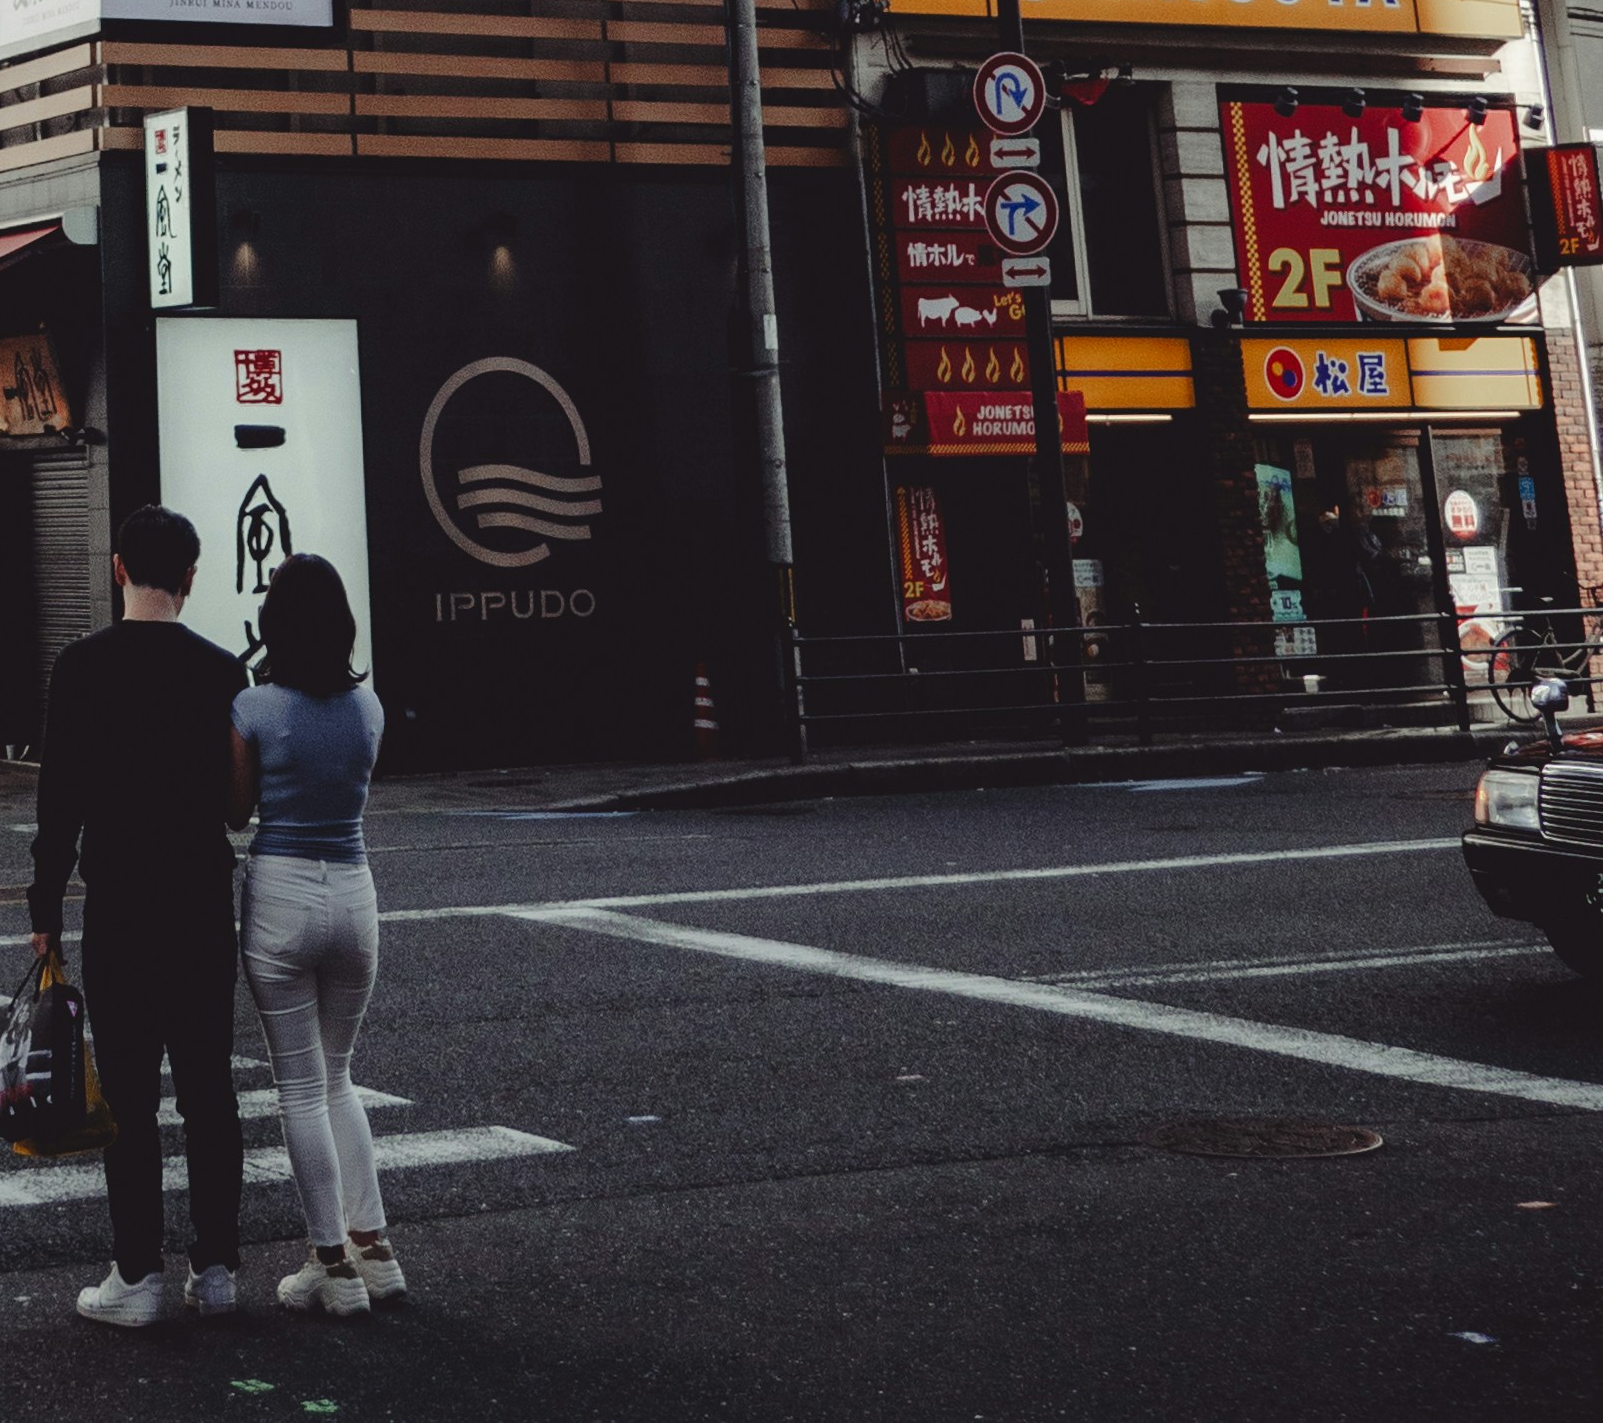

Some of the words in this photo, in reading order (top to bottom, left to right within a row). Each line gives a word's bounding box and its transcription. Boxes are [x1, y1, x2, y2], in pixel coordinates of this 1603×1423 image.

[213, 0, 241, 9] MINA
[246, 0, 293, 10] MENDOU
[173, 125, 182, 203] ラーメン
[1256, 125, 1502, 209] 情熱ホルモン
[1320, 210, 1382, 227] JONETSU
[1385, 211, 1456, 228] HORUMON
[1559, 238, 1580, 255] 2F
[1267, 247, 1343, 308] 2F
[1313, 352, 1390, 396] 松屋
[976, 404, 1034, 420] JONETS
[972, 421, 1035, 437] HORUMO
[904, 581, 925, 599] 2F
[435, 589, 597, 623] IPPUDO
